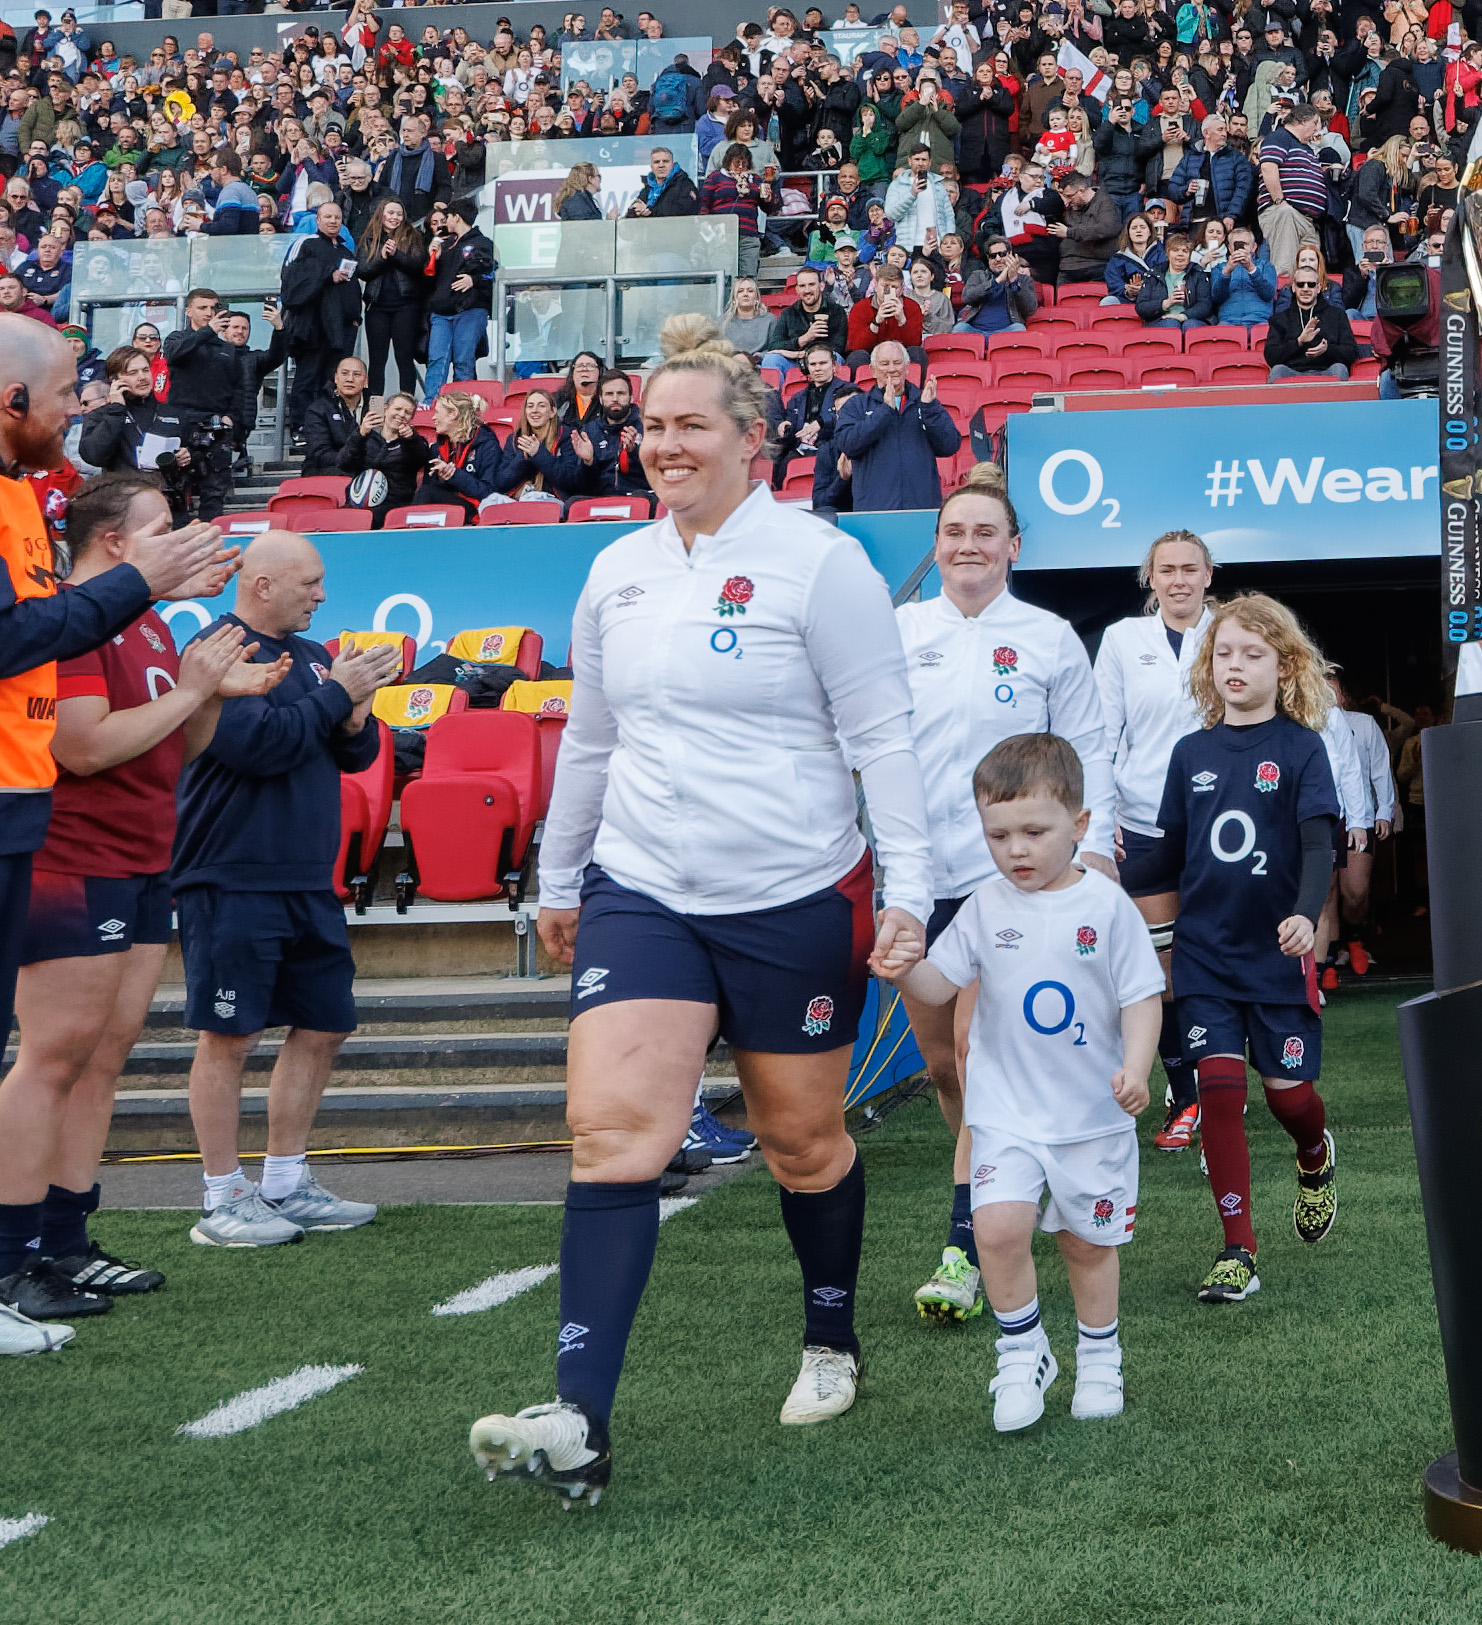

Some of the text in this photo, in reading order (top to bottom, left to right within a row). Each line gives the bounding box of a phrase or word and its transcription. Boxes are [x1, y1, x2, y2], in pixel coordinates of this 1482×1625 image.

[505, 193, 561, 222] W1
[1446, 314, 1466, 415] GUINNESS
[1039, 449, 1121, 528] O2
[1447, 502, 1466, 606] GUINNESS
[710, 628, 743, 660] O2
[994, 684, 1018, 708] O2
[1210, 809, 1268, 876] O2
[216, 988, 236, 1001] AJB
[1023, 980, 1088, 1046] O2
